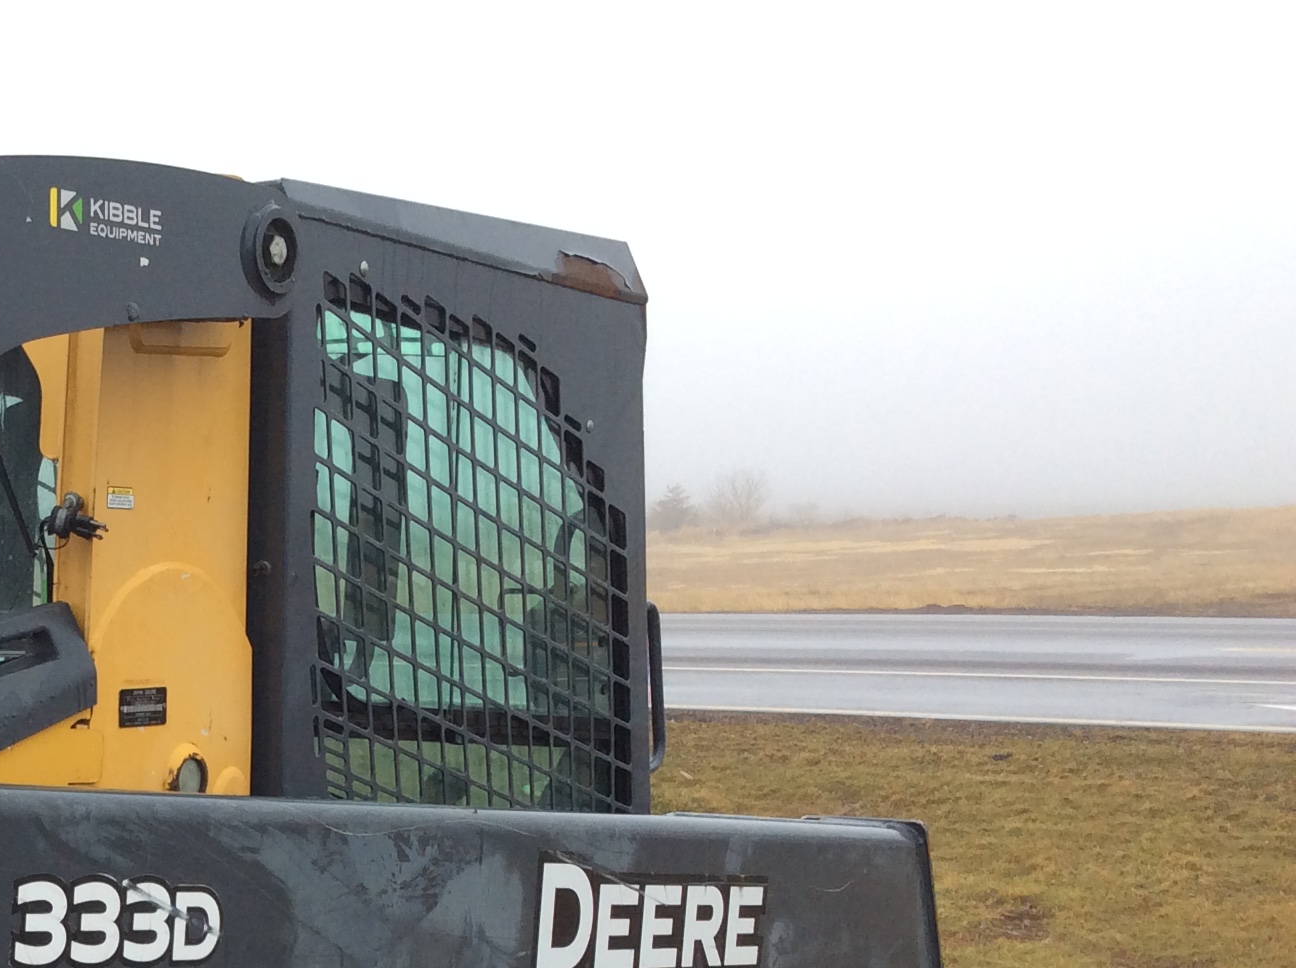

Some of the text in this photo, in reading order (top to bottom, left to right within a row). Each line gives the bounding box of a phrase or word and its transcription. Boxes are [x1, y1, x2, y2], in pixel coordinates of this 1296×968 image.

[89, 198, 162, 231] KIBBLE
[89, 222, 162, 247] EQUIPMENT
[13, 880, 222, 966] 333D
